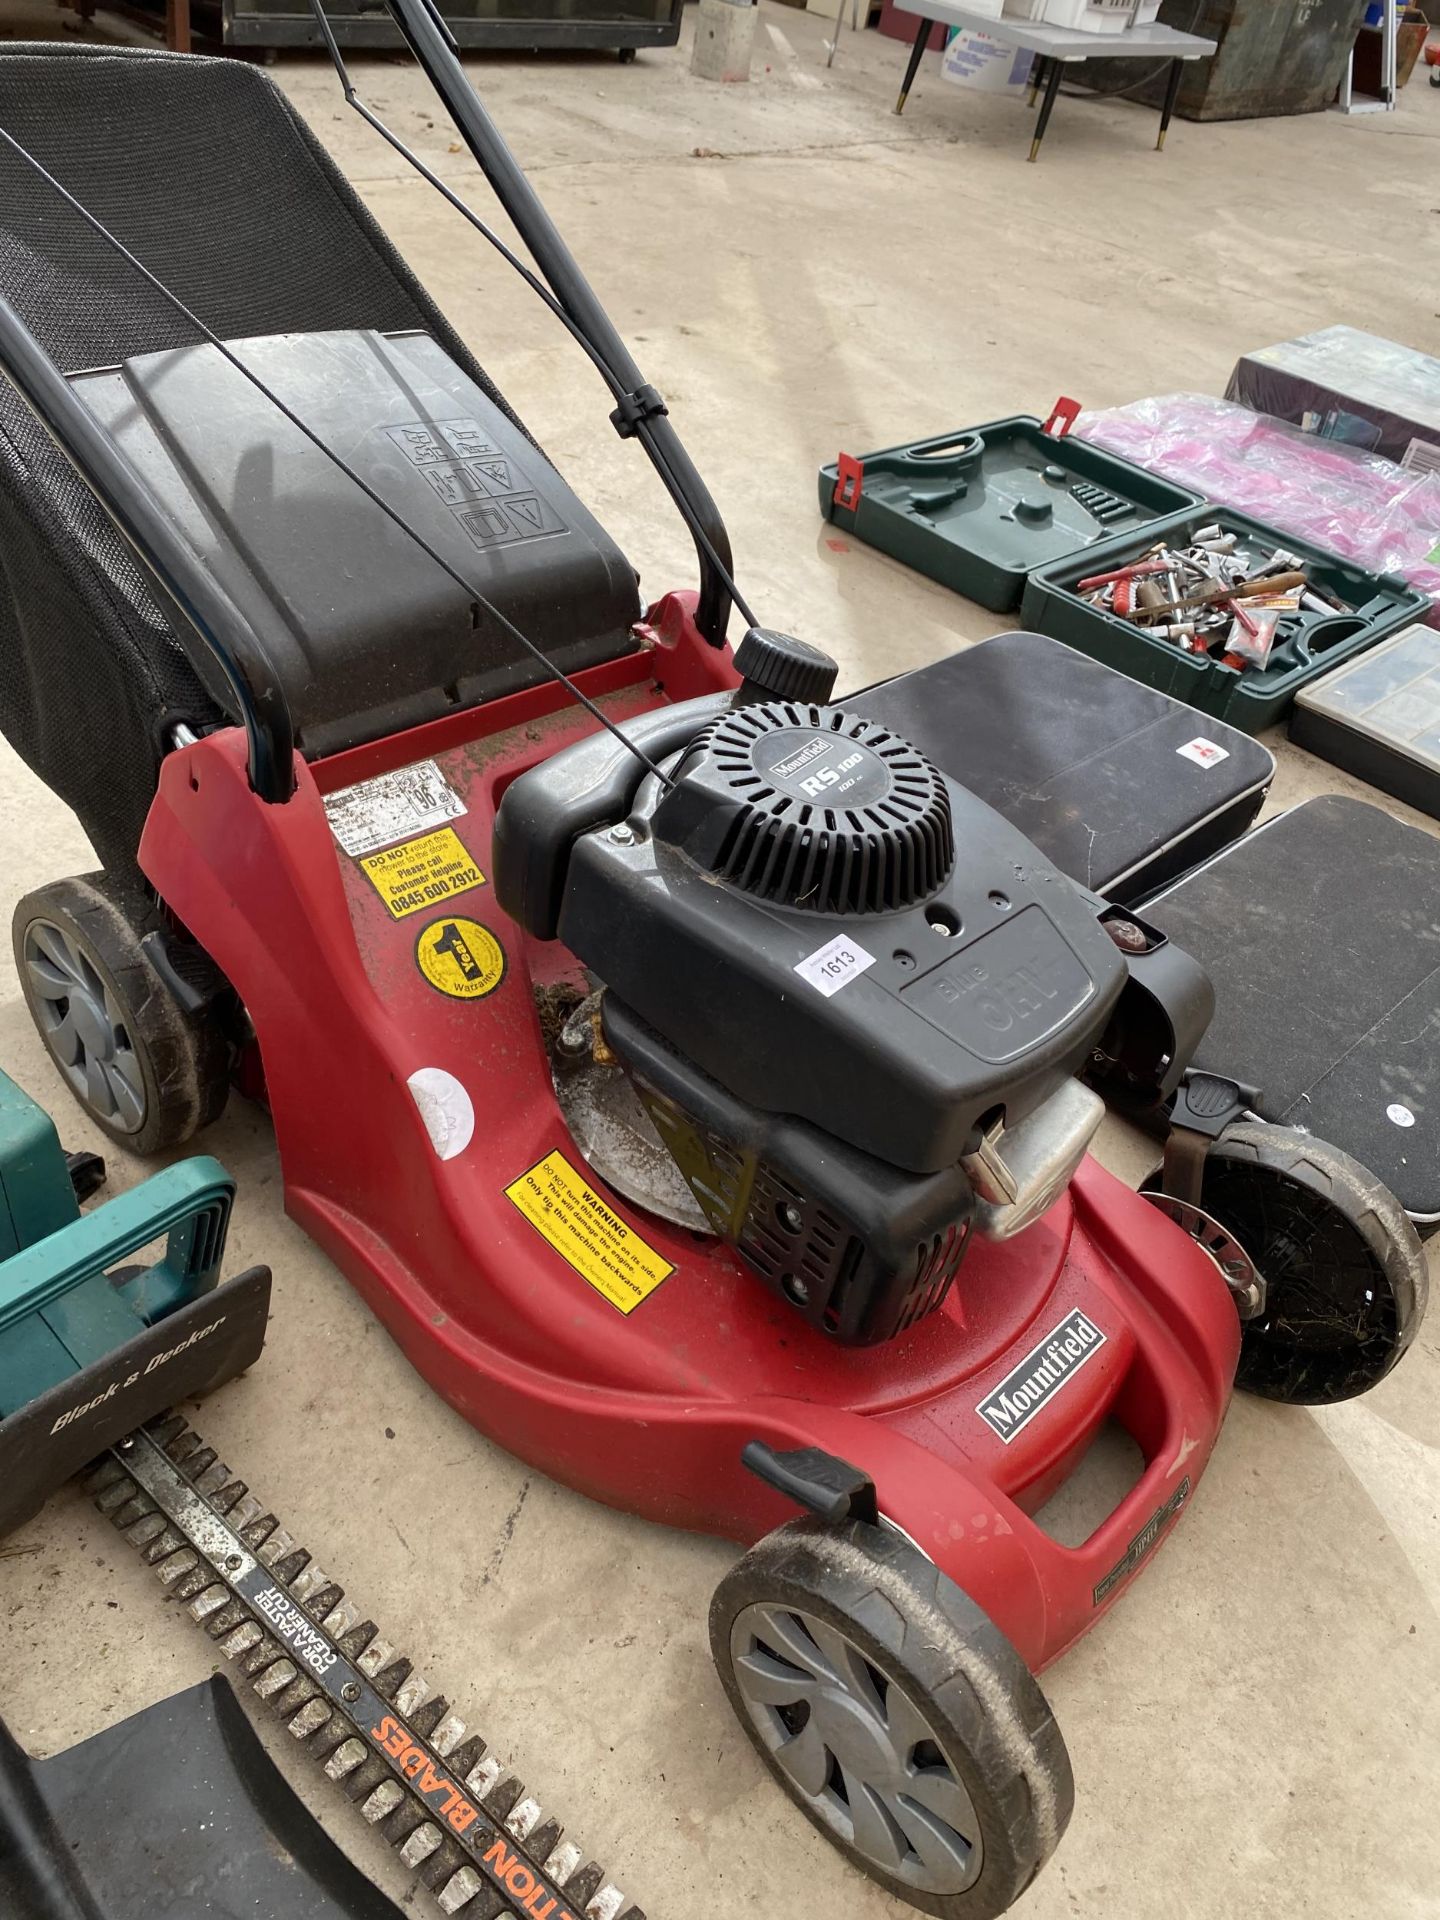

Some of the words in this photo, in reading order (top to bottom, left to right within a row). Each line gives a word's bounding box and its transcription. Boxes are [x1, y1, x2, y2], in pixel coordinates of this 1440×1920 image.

[775, 739, 830, 776] Mountfield
[799, 766, 840, 797] RS
[837, 752, 864, 773] 100
[414, 786, 437, 809] 96
[838, 778, 856, 792] 100
[368, 856, 386, 868] DO
[386, 847, 409, 861] NOT
[411, 839, 434, 853] return
[378, 860, 405, 874] mower
[405, 855, 415, 864] to
[415, 849, 429, 859] the
[429, 842, 449, 854] store
[397, 862, 426, 879] Please
[427, 855, 443, 867] call
[389, 873, 431, 895] Customer
[430, 860, 464, 879] Helpline
[390, 889, 425, 913] 0845
[424, 880, 449, 899] 600
[449, 868, 480, 889] 2912
[433, 923, 484, 982] 1
[451, 939, 475, 973] Year
[820, 951, 856, 978] 1613
[454, 971, 497, 992] Warranty
[524, 1200, 545, 1224] cleaning
[543, 1222, 561, 1239] please
[559, 1237, 572, 1250] refer
[571, 1248, 578, 1257] to
[577, 1255, 587, 1267] the
[526, 1177, 544, 1196] Only
[543, 1196, 554, 1209] tip
[553, 1208, 569, 1224] this
[568, 1224, 601, 1257] machine
[601, 1256, 643, 1296] backwards
[543, 1163, 554, 1175] DO
[553, 1174, 568, 1190] NOT
[566, 1189, 580, 1206] turn
[581, 1205, 593, 1219] this
[593, 1218, 621, 1246] machine
[621, 1246, 631, 1256] on
[631, 1255, 640, 1265] its
[640, 1265, 657, 1281] side.
[547, 1182, 561, 1199] This
[561, 1198, 574, 1212] will
[573, 1211, 599, 1238] damage
[599, 1237, 611, 1250] the
[611, 1250, 635, 1274] engine.
[581, 1190, 628, 1239] WARNING
[49, 1381, 120, 1436] Black
[123, 1371, 140, 1388] &
[143, 1316, 228, 1376] Decker
[984, 1316, 1099, 1433] Mountfield
[253, 1591, 296, 1638] FASTER
[264, 1587, 290, 1611] CUT
[285, 1609, 338, 1665] CLEANER
[293, 1634, 307, 1647] A
[302, 1645, 330, 1675] FOR
[370, 1715, 479, 1834] BLADES
[482, 1839, 573, 1920] TION
